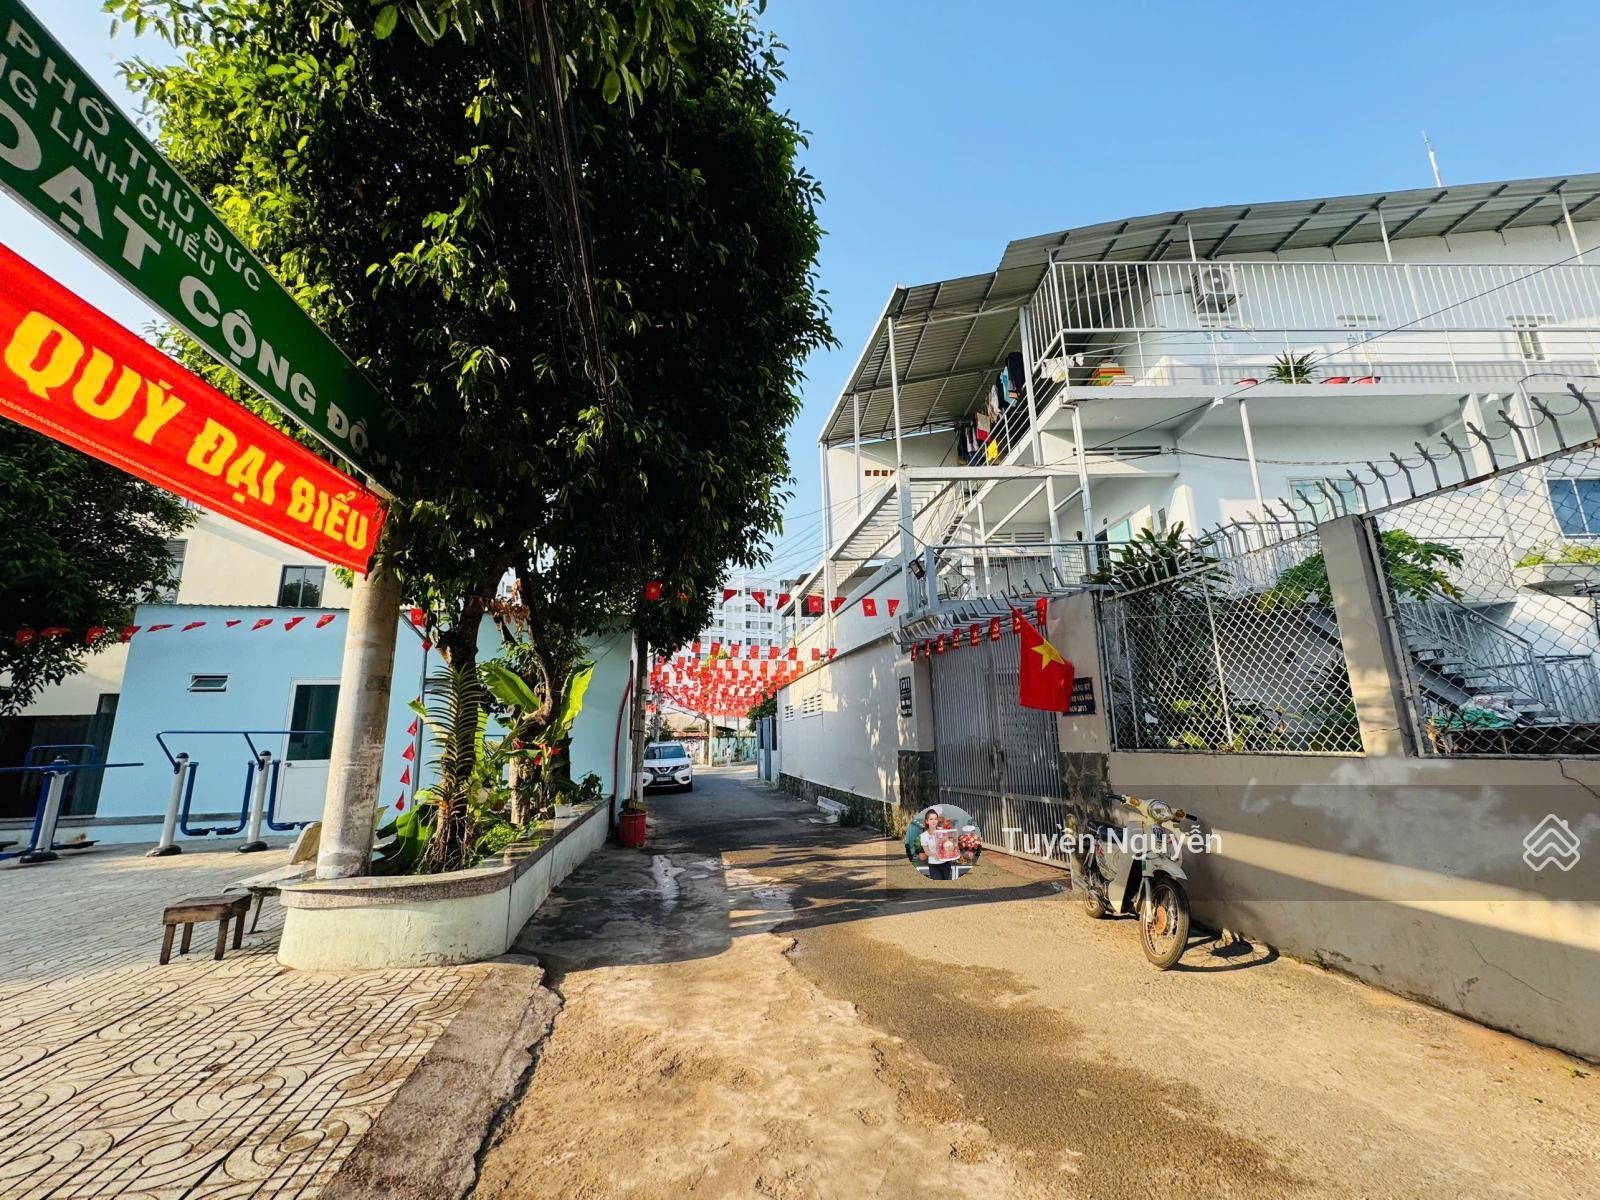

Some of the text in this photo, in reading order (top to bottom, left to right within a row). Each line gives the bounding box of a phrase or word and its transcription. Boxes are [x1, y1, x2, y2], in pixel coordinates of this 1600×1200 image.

[6, 19, 261, 292] PHỐ THỦ ĐỨC
[50, 107, 129, 195] LINH
[138, 193, 216, 276] CHIỂU
[4, 311, 368, 550] QUÝ ĐẠI BIỂU
[179, 275, 317, 416] CỘNG
